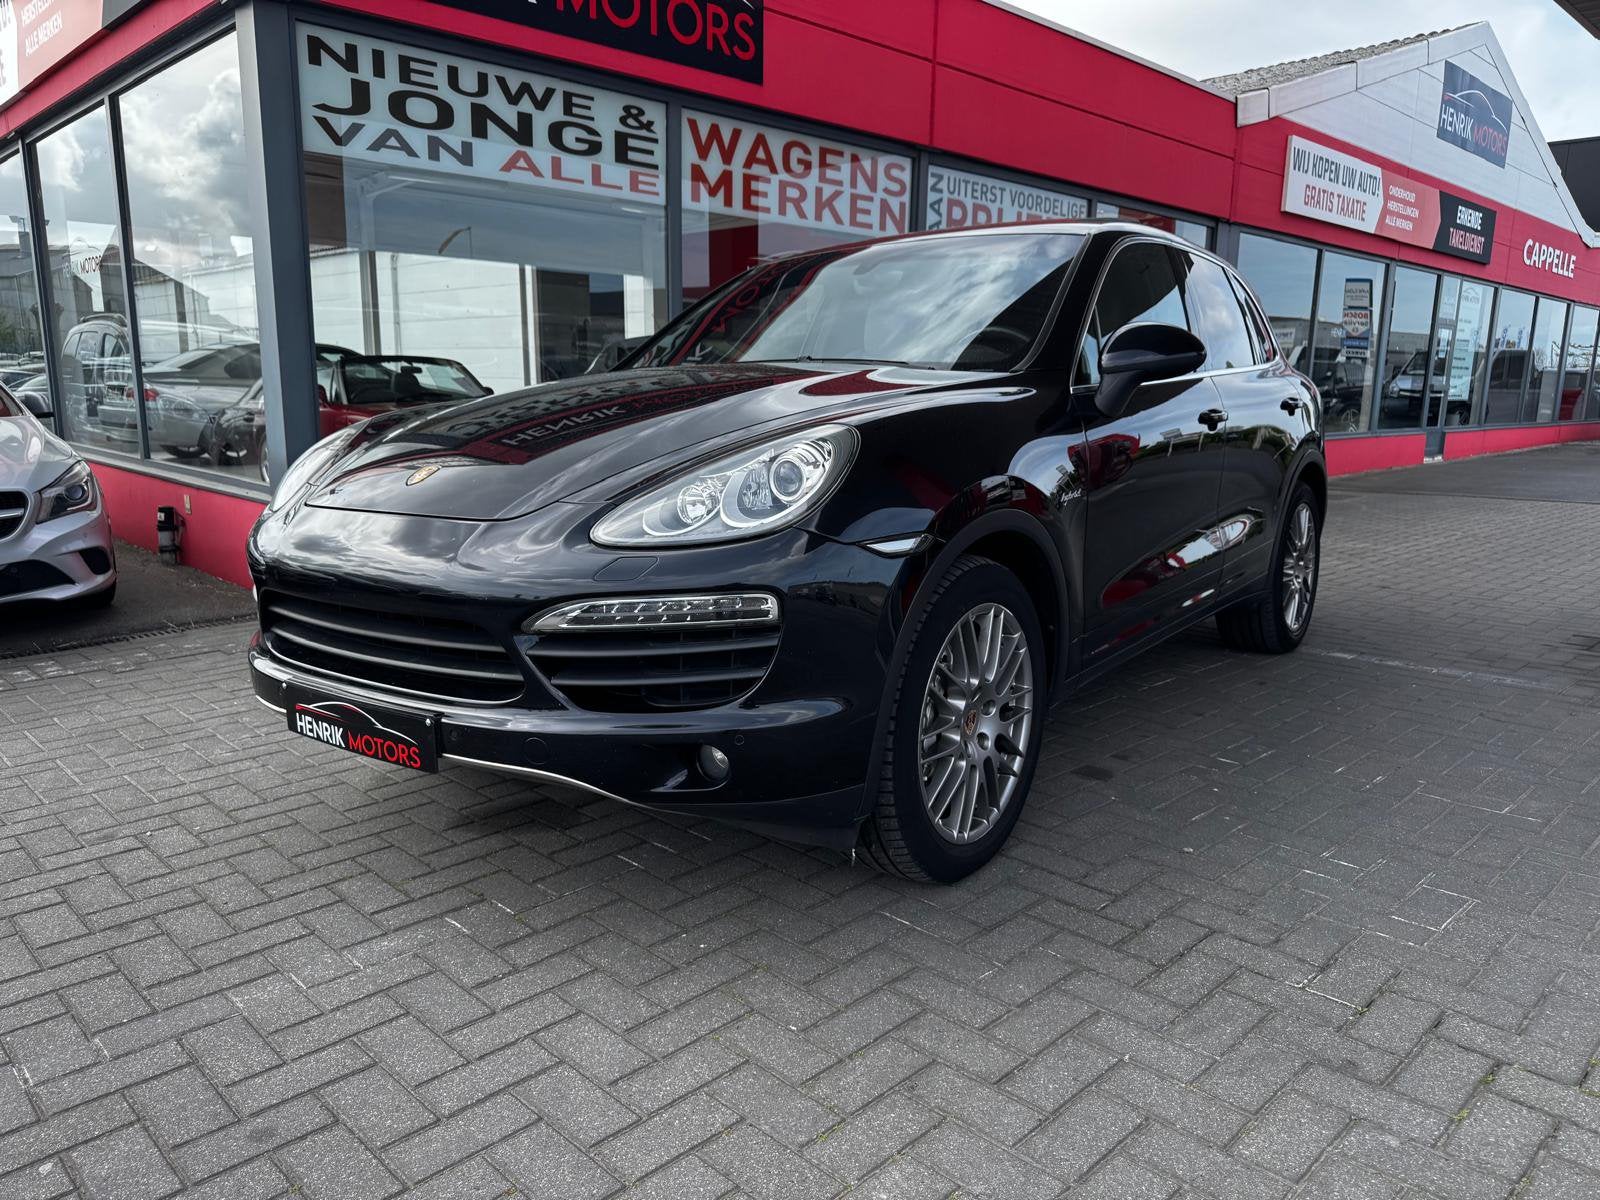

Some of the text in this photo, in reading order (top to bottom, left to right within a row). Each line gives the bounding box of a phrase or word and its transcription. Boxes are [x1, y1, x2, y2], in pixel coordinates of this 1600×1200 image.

[306, 34, 657, 135] NIEUWE &
[311, 77, 660, 171] JONGE
[1440, 103, 1508, 157] HENRIK MOTORS
[311, 115, 660, 197] VAN ALLE
[686, 117, 908, 198] WAGENS
[1293, 146, 1381, 198] WIJ KOPEN UW AUTO!
[690, 162, 907, 235] MERKEN
[946, 175, 1007, 204] UITERST
[1009, 189, 1087, 219] VOORDELIGE
[1303, 184, 1367, 222] GRATIS TAXATIE
[1387, 200, 1420, 219] HERSTELLINGEN
[1388, 185, 1416, 203] ONDERHOUD
[1456, 205, 1483, 231] ERKENDE
[1385, 215, 1414, 232] ALLE MERKEN
[1448, 228, 1485, 255] TAKELDIENST
[1523, 238, 1577, 279] CAPPELLE
[295, 712, 421, 768] HENRIK MOTORS
